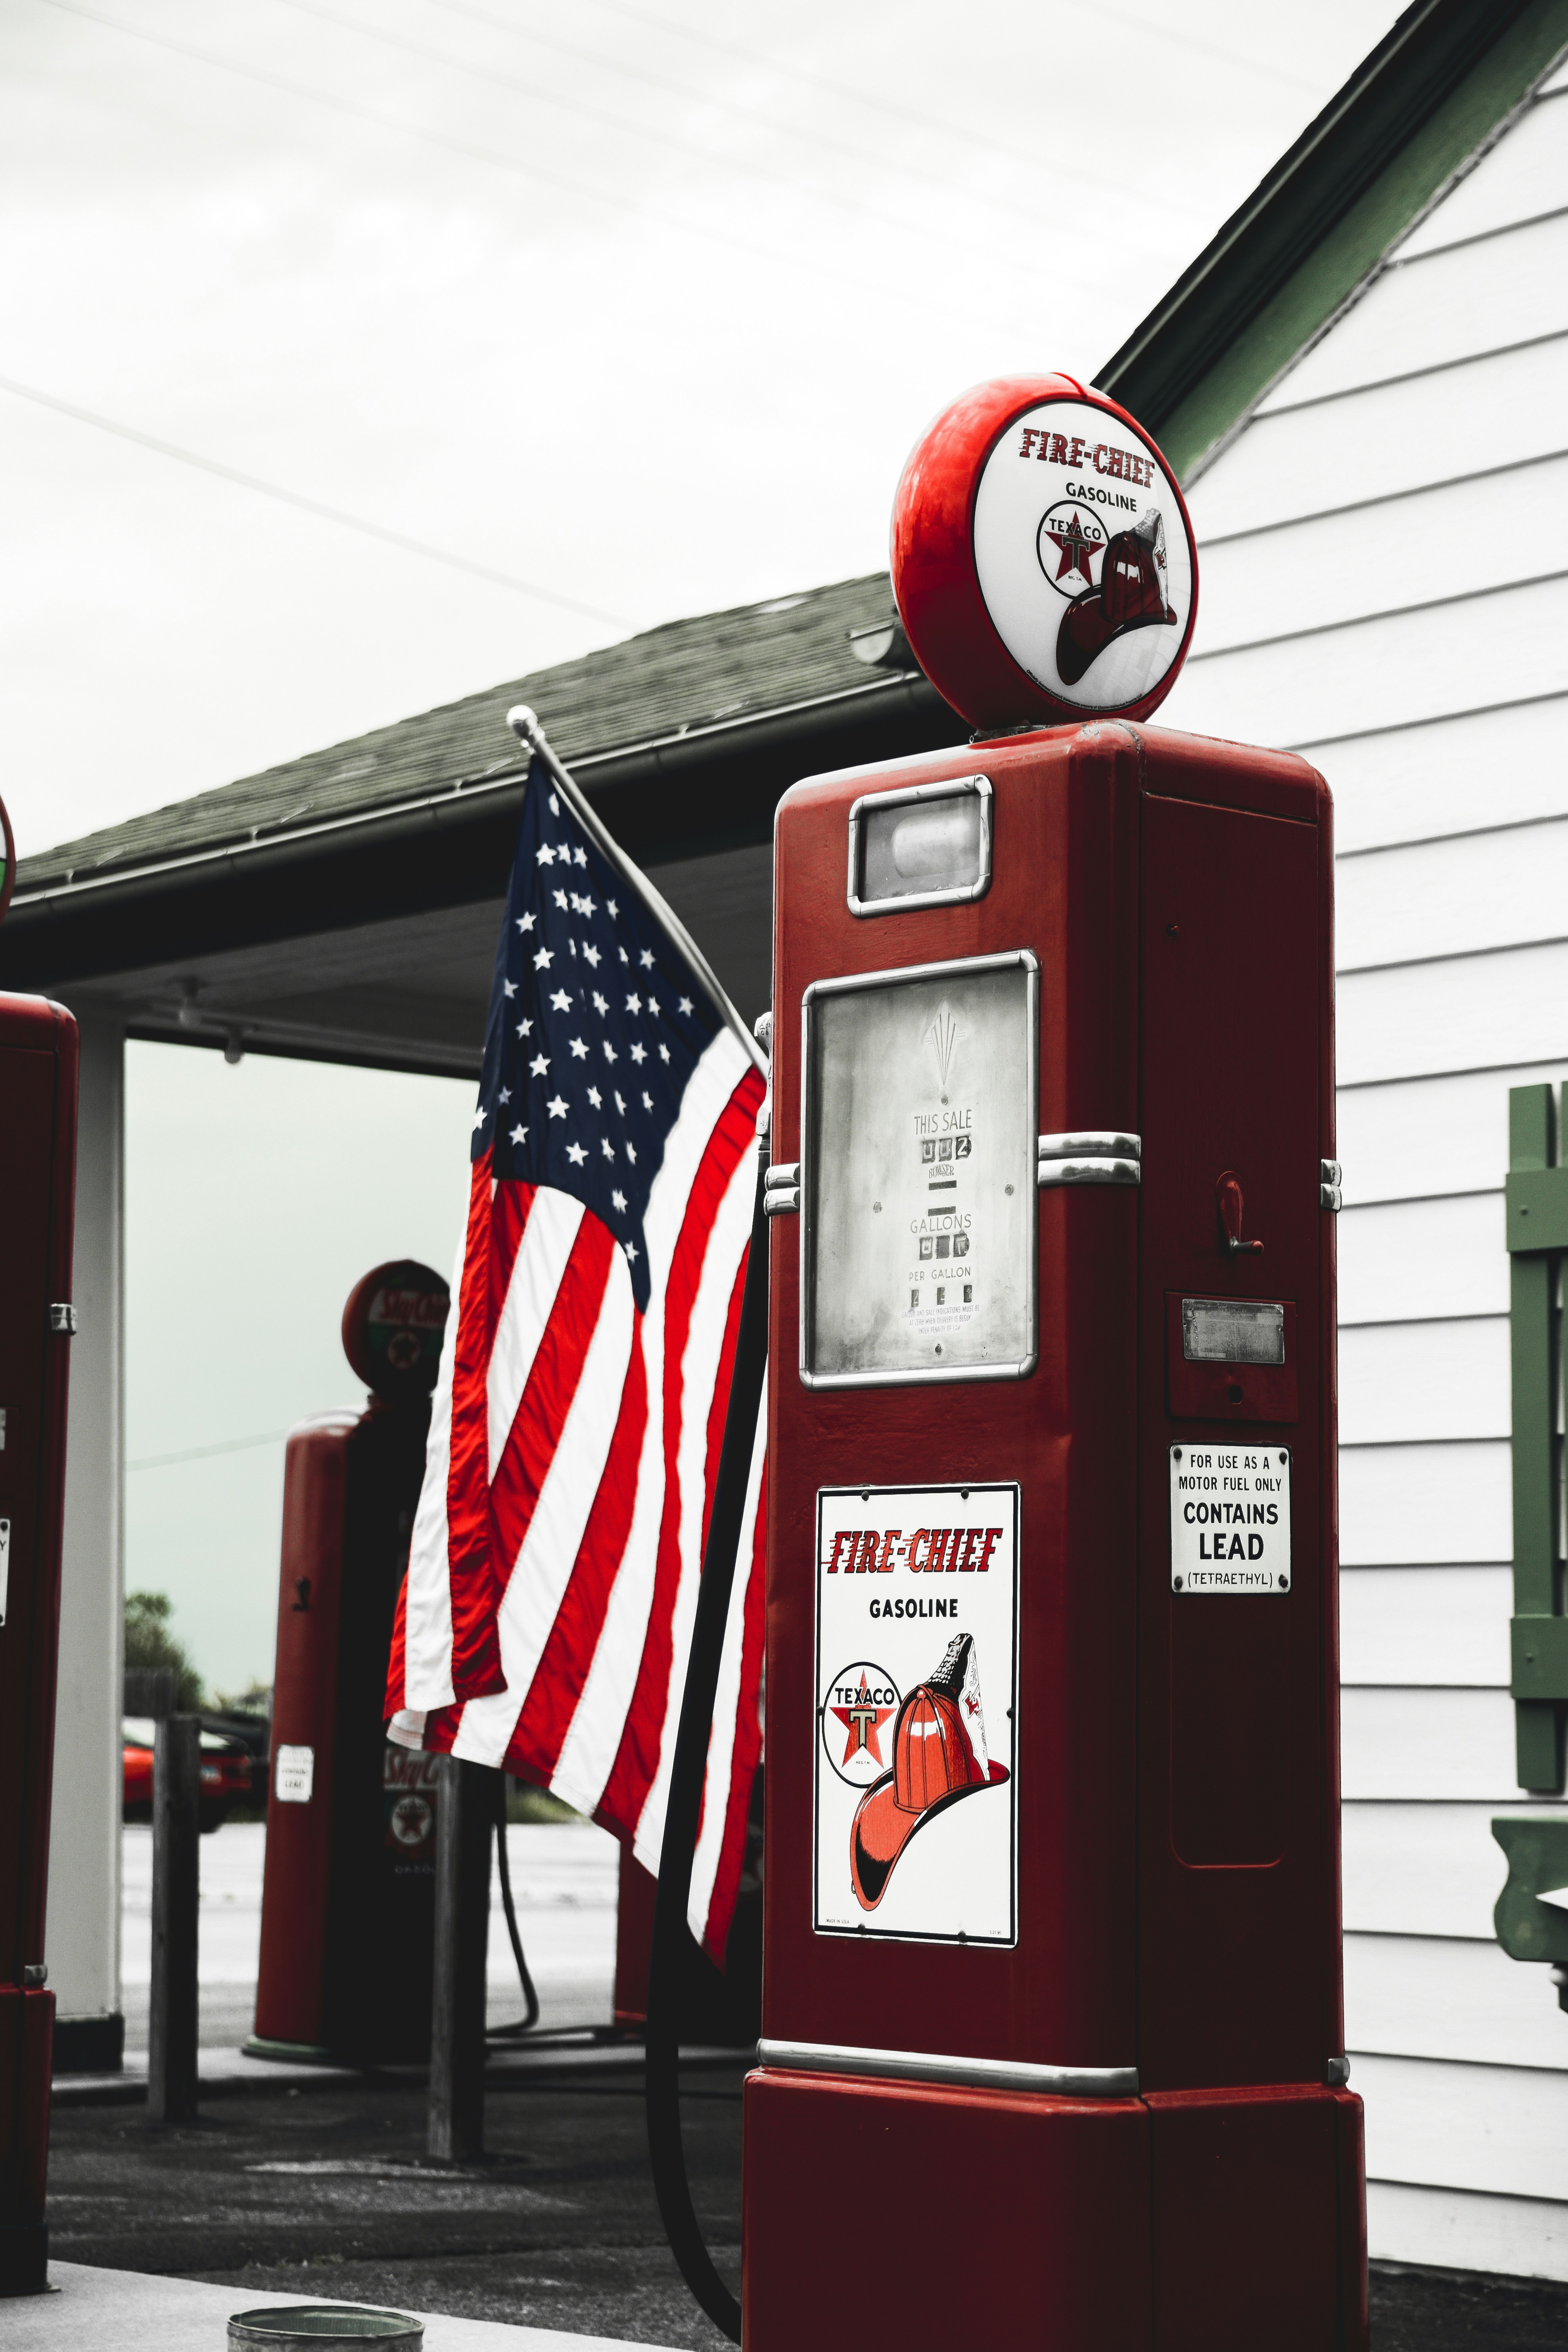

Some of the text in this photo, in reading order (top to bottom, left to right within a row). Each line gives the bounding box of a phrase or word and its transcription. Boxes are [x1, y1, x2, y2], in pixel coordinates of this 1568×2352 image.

[1019, 428, 1155, 489] FIRE-CHIEF
[1066, 482, 1137, 512] GASOLINE
[1049, 518, 1101, 540] TEXACO
[914, 1109, 972, 1135] THIS SALE
[929, 1164, 954, 1178] BOWSER
[911, 1214, 971, 1233] GALLONS
[909, 1267, 970, 1282] PER GALLON
[936, 1306, 960, 1315] INDICATIONS
[1190, 1455, 1270, 1469] FOR USE AS A
[1179, 1476, 1282, 1491] MOTOR FUEL ONLY
[1184, 1502, 1278, 1525] CONTAINS
[826, 1528, 1003, 1574] FIRE-CHIEF
[1200, 1533, 1264, 1560] LEAD
[1188, 1572, 1273, 1588] (TETRAETHYL)
[870, 1599, 958, 1618] GASOLINE
[835, 1687, 895, 1705] TEXACO
